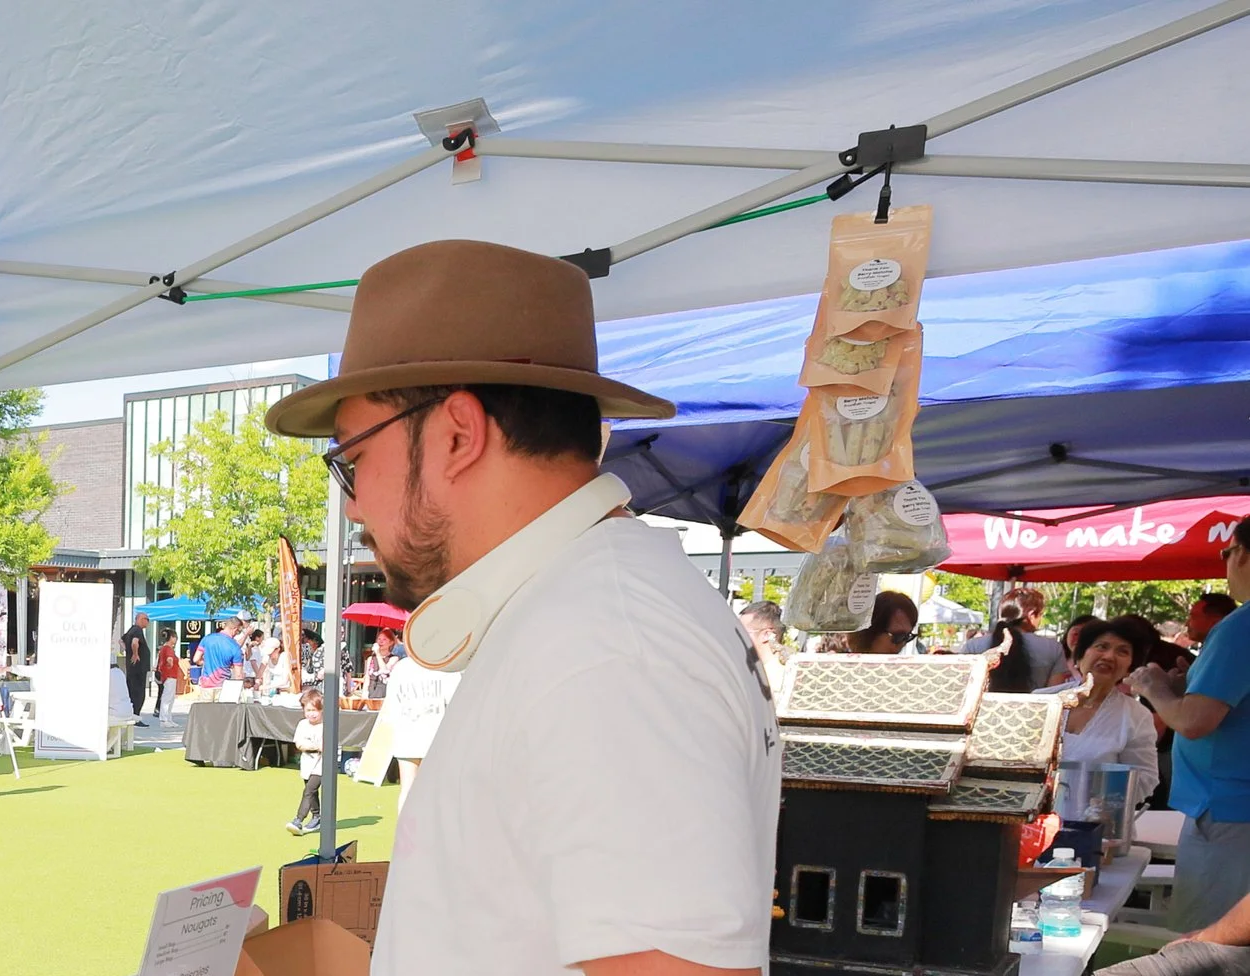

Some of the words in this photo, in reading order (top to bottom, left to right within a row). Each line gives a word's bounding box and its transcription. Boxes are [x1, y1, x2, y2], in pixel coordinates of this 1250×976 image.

[983, 508, 1048, 551] We
[1065, 506, 1187, 548] make
[190, 891, 224, 911] Pricing
[181, 916, 218, 935] Nougats
